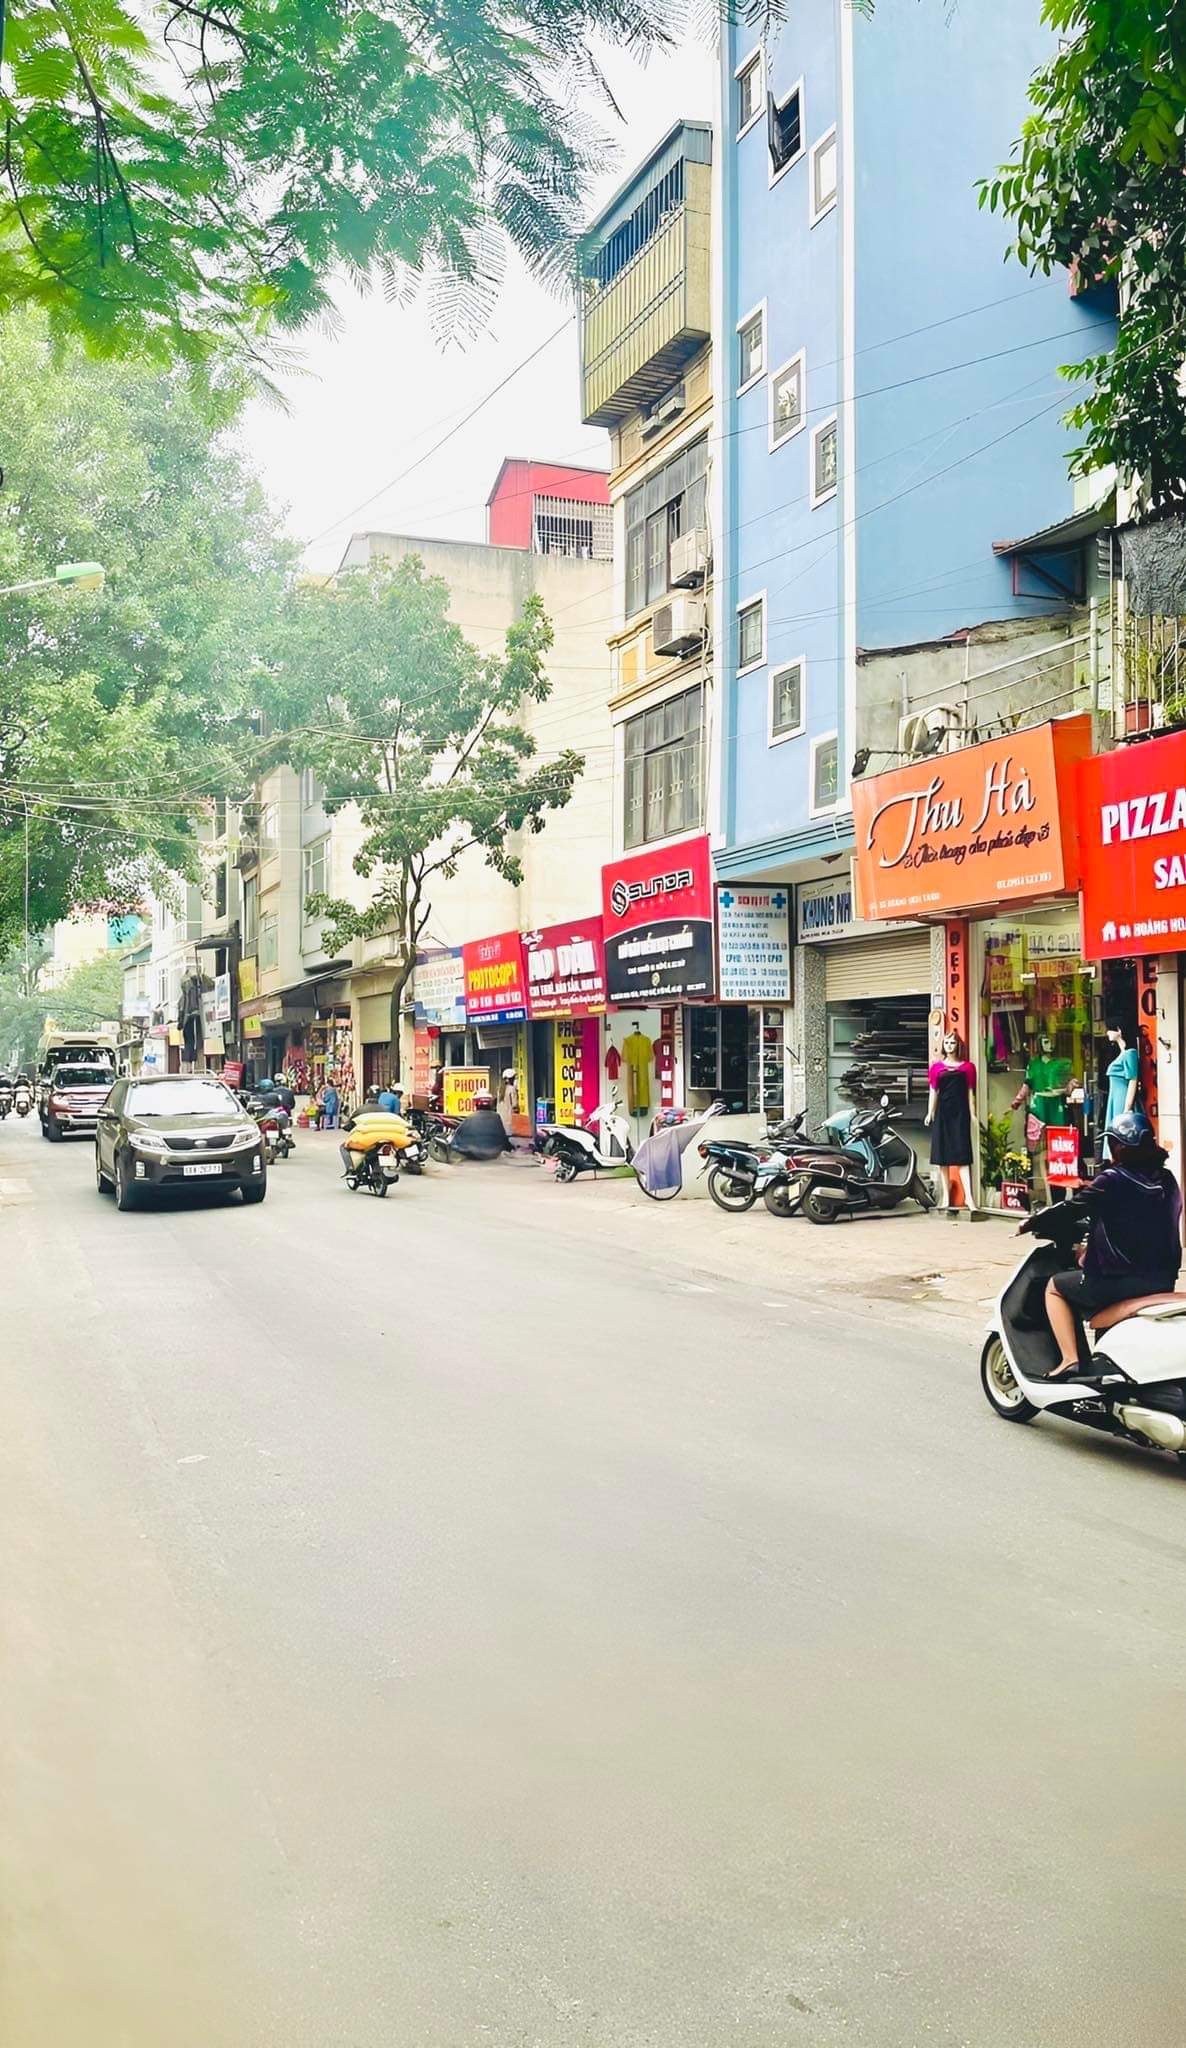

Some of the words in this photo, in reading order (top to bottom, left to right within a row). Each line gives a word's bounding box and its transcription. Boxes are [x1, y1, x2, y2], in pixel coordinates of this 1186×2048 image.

[867, 776, 964, 868] Thu
[971, 757, 1036, 833] Hà
[1101, 787, 1186, 845] PIZZA
[1154, 855, 1186, 890] SA
[803, 895, 834, 930] KHUNG
[1170, 917, 1186, 932] HO
[468, 961, 517, 992] PHOTOCOPY
[454, 1078, 487, 1093] PHOTO
